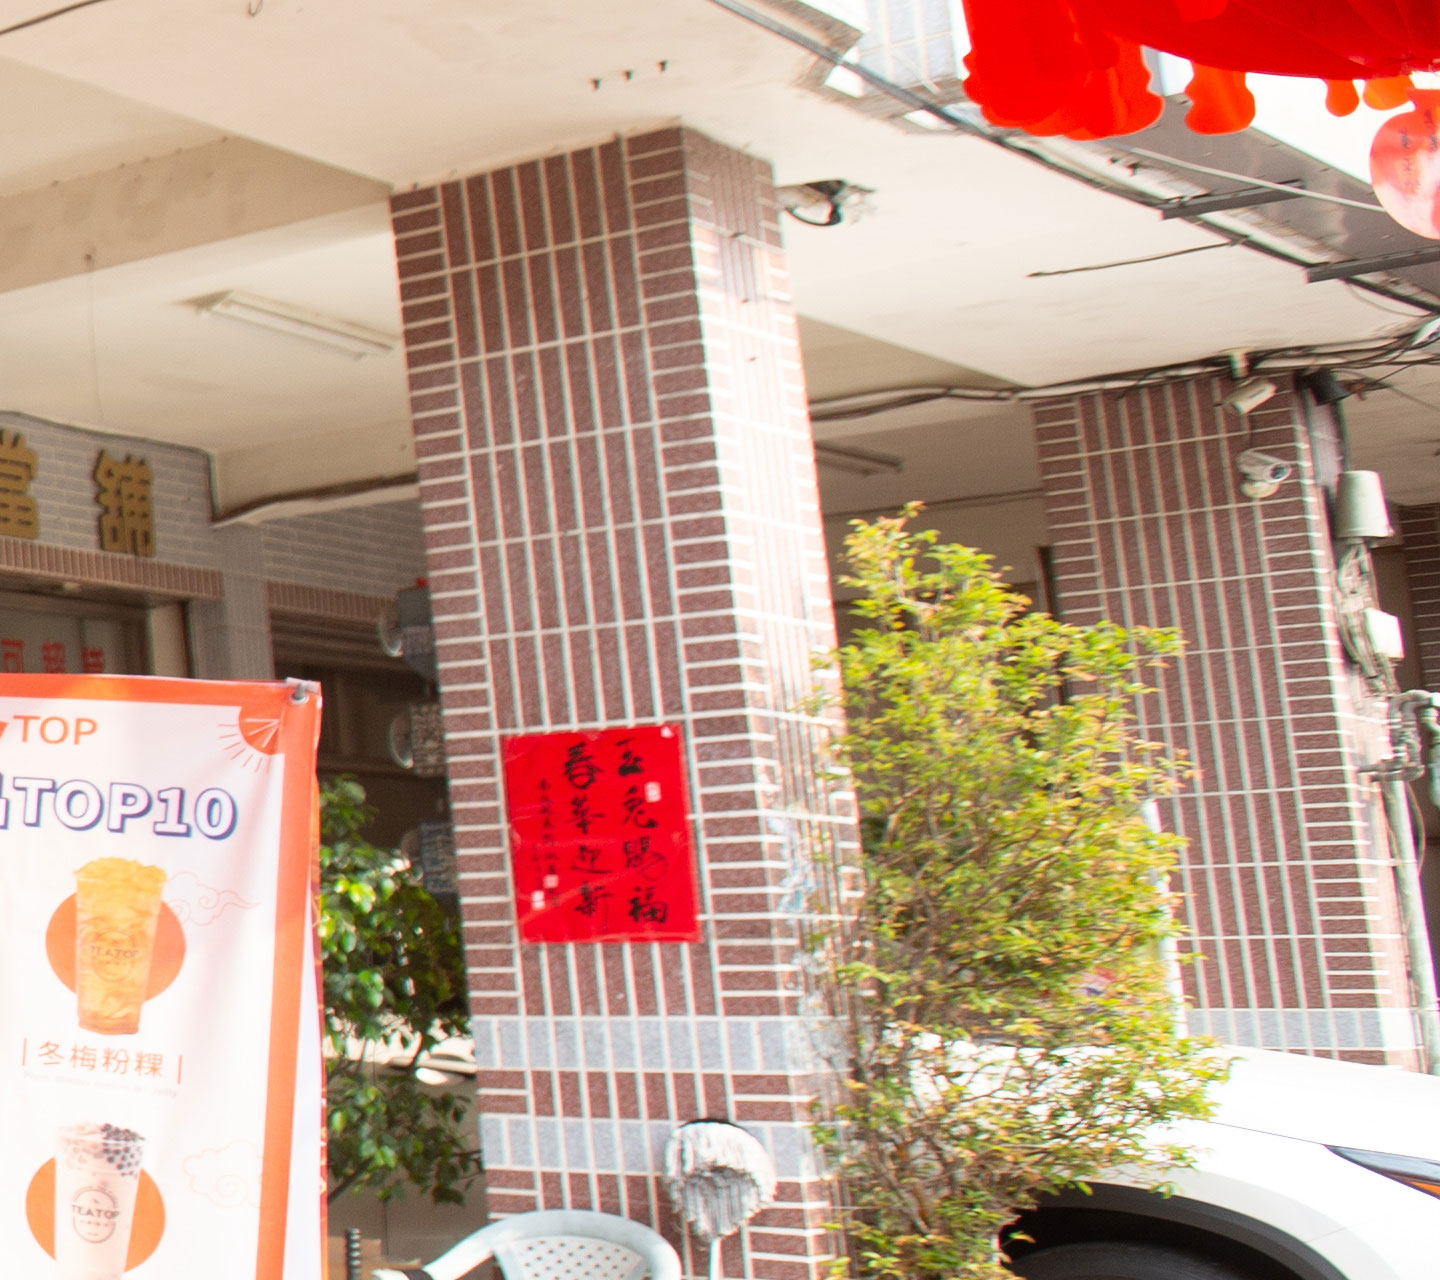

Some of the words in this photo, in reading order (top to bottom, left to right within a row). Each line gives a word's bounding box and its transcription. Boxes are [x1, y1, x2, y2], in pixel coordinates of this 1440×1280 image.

[11, 713, 99, 746] TOP
[37, 1041, 165, 1078] 冬梅粉粿
